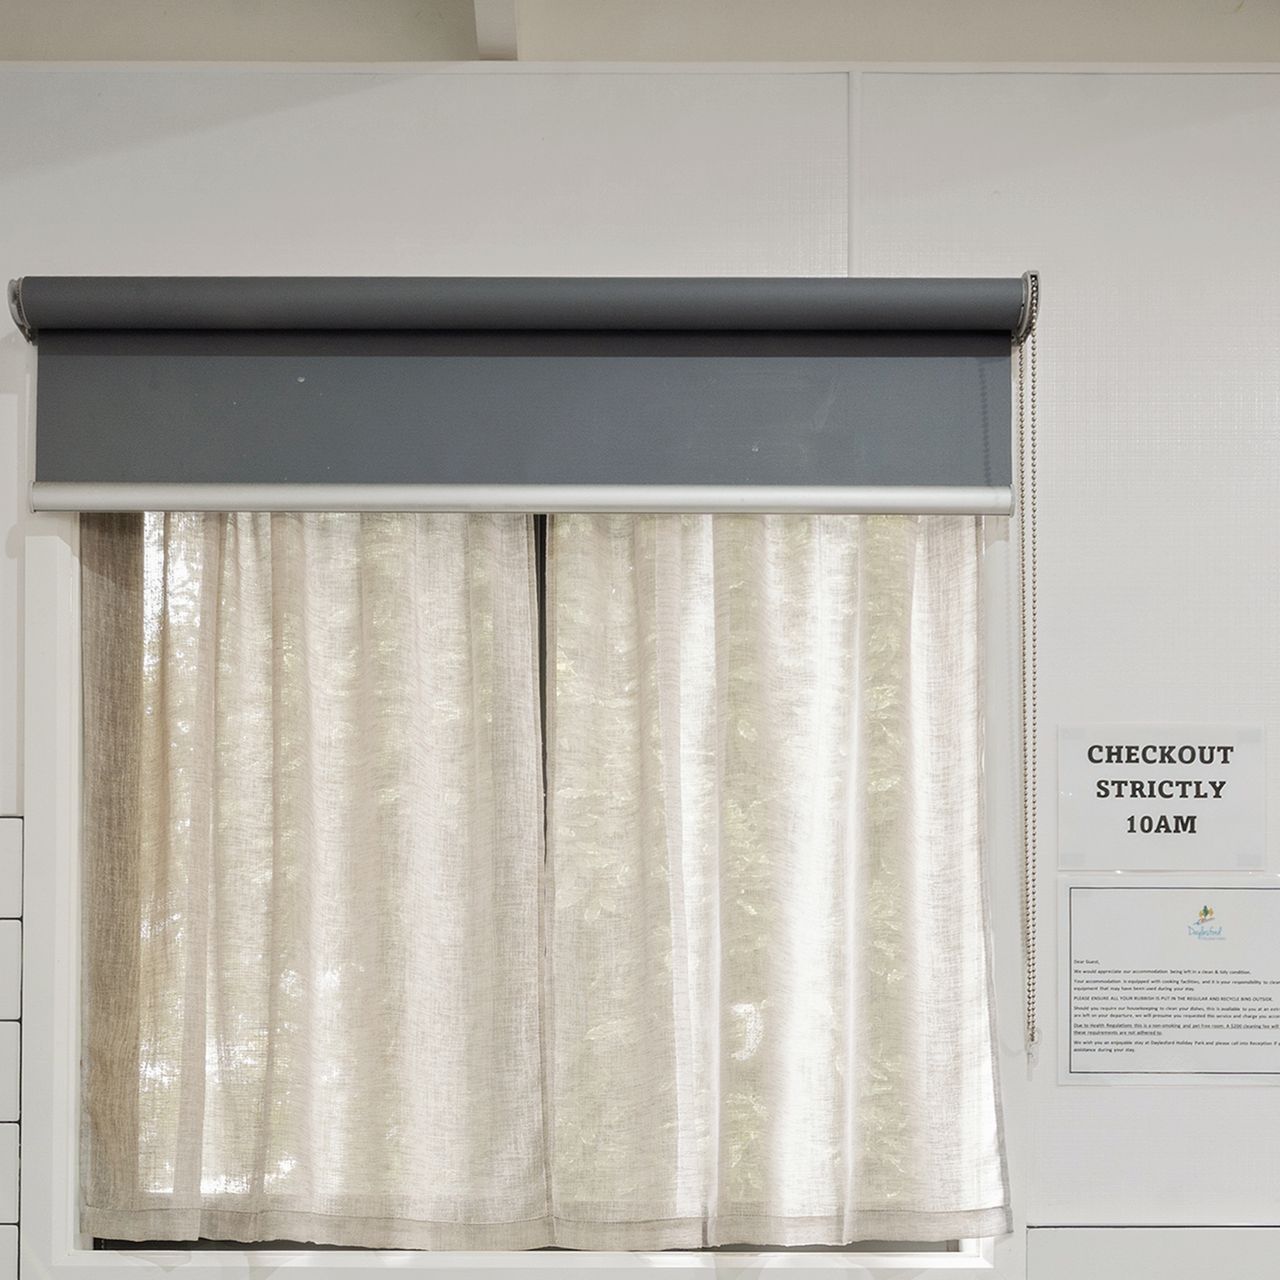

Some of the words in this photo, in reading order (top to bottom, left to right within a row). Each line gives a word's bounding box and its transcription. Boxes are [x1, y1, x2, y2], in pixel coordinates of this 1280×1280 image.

[1087, 744, 1234, 764] CHECKOUT
[1096, 780, 1226, 799] STRICTLY
[1127, 816, 1198, 834] 10AM
